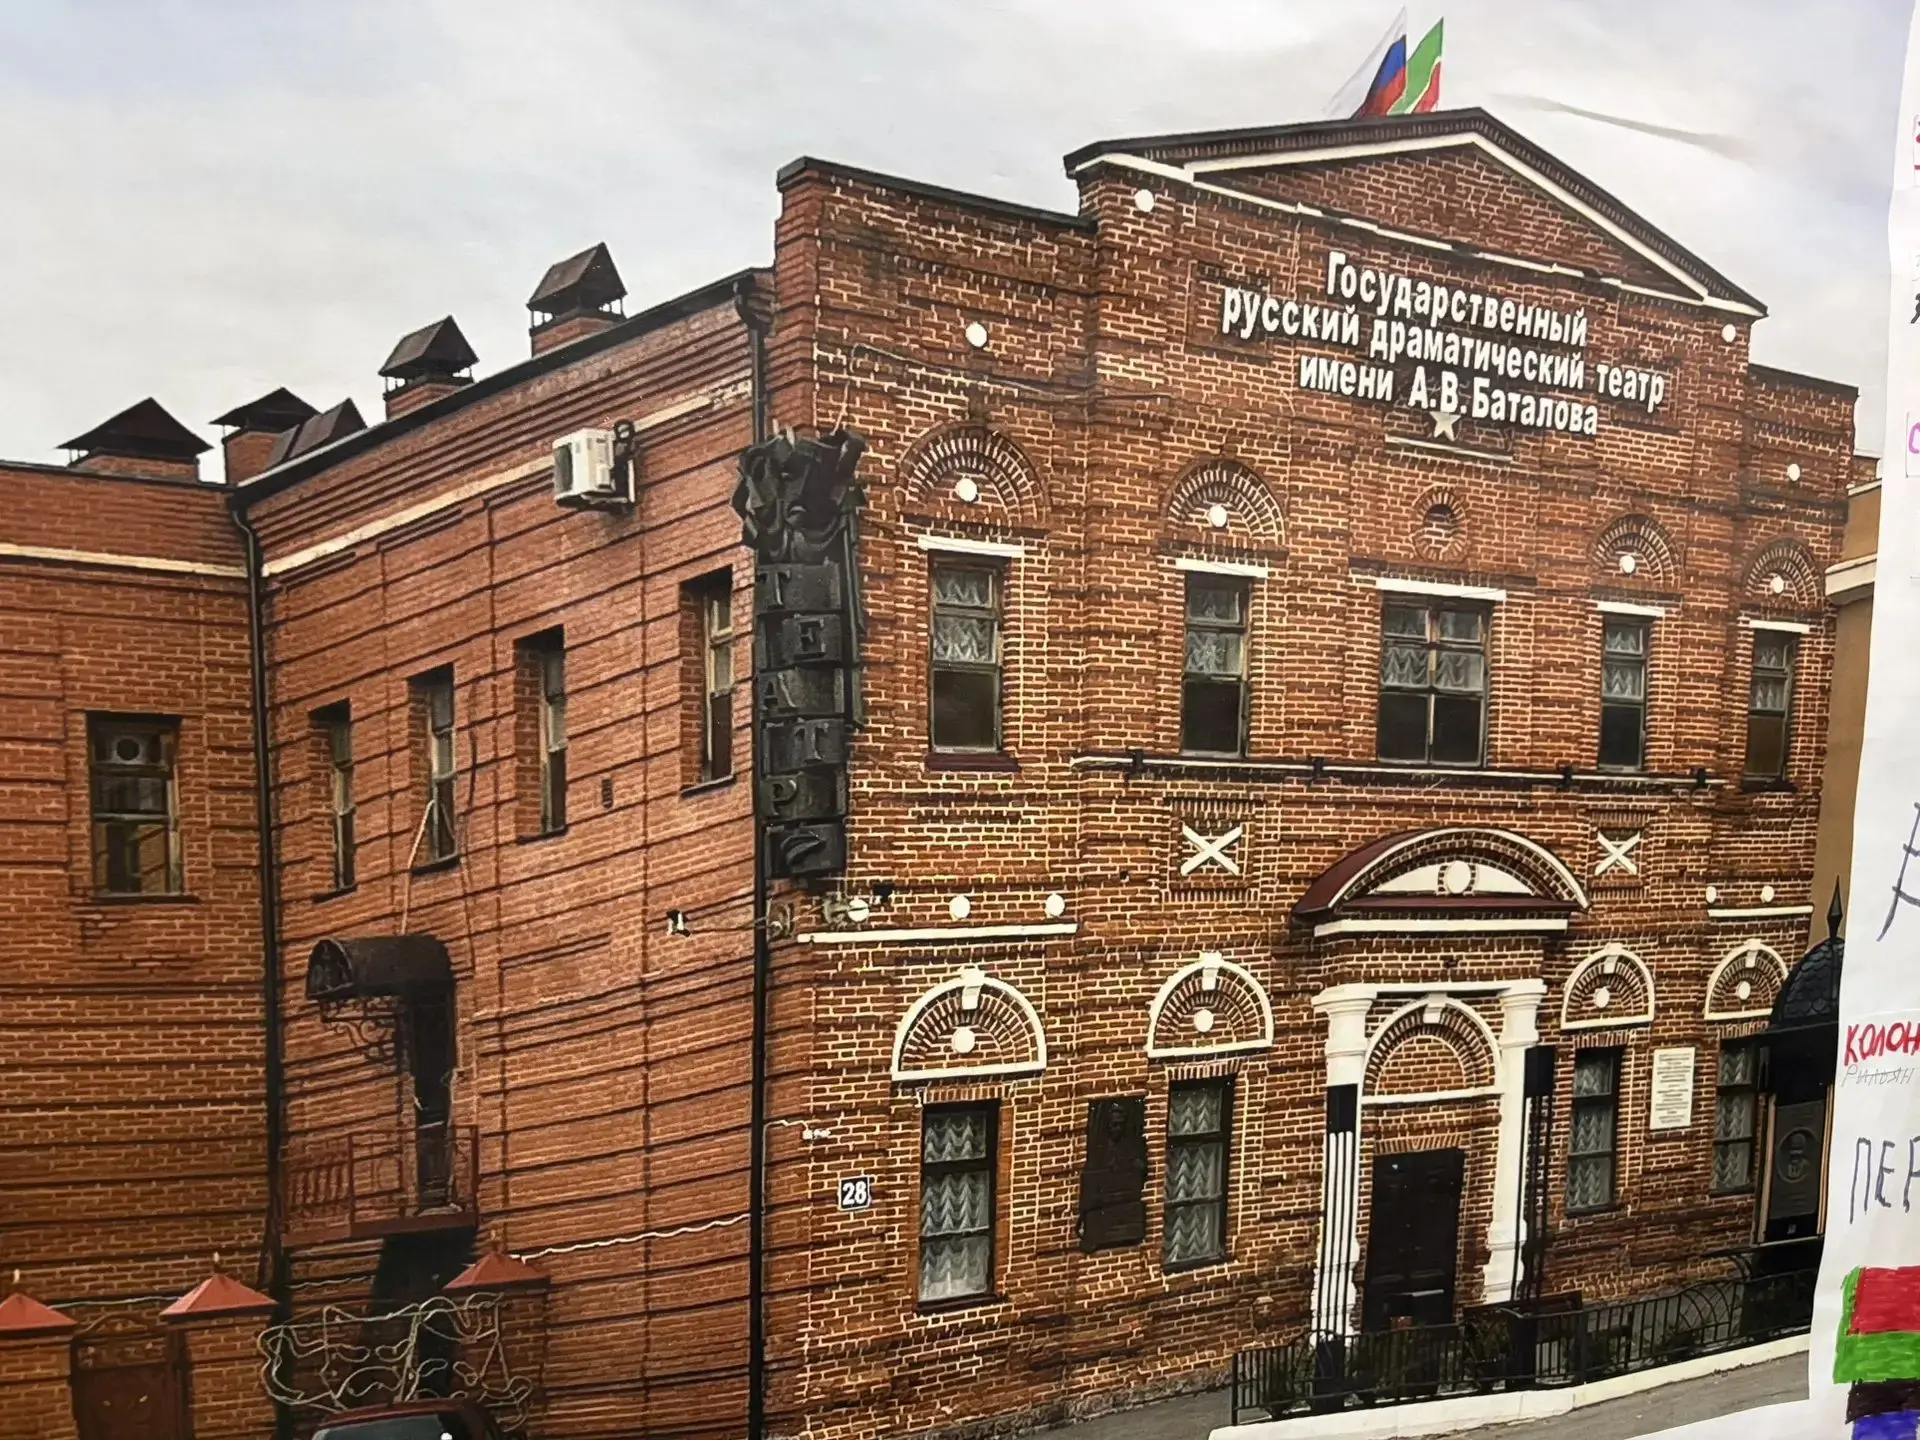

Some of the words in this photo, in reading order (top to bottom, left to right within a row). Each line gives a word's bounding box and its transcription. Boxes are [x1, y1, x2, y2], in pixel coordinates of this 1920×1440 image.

[1326, 250, 1588, 347] Государственный
[1222, 286, 1360, 346] русский
[1369, 318, 1585, 390] драматический
[1596, 363, 1664, 413] театр
[1300, 355, 1394, 401] имени
[842, 1180, 868, 1206] 28
